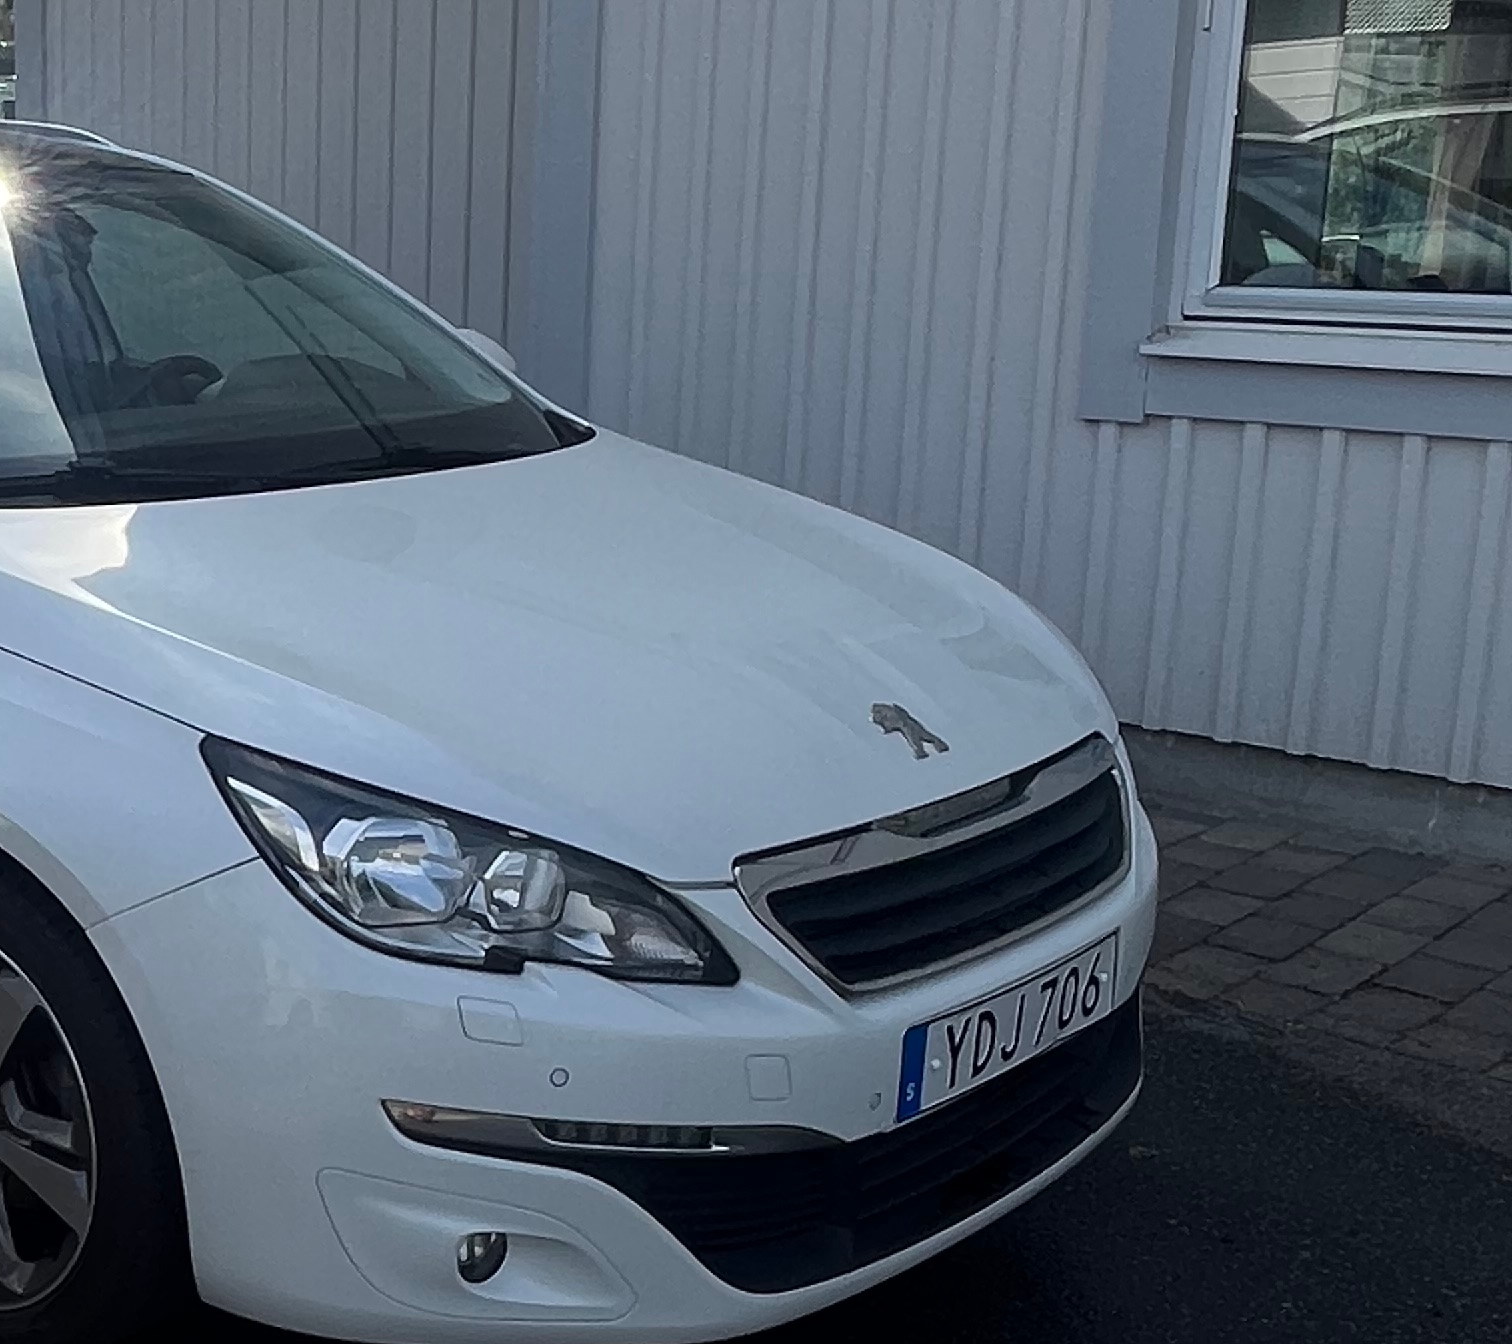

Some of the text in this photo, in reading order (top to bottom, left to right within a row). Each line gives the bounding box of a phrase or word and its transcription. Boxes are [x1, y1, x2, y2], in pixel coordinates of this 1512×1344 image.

[945, 953, 1101, 1089] YDJ 706
[906, 1082, 916, 1101] S
